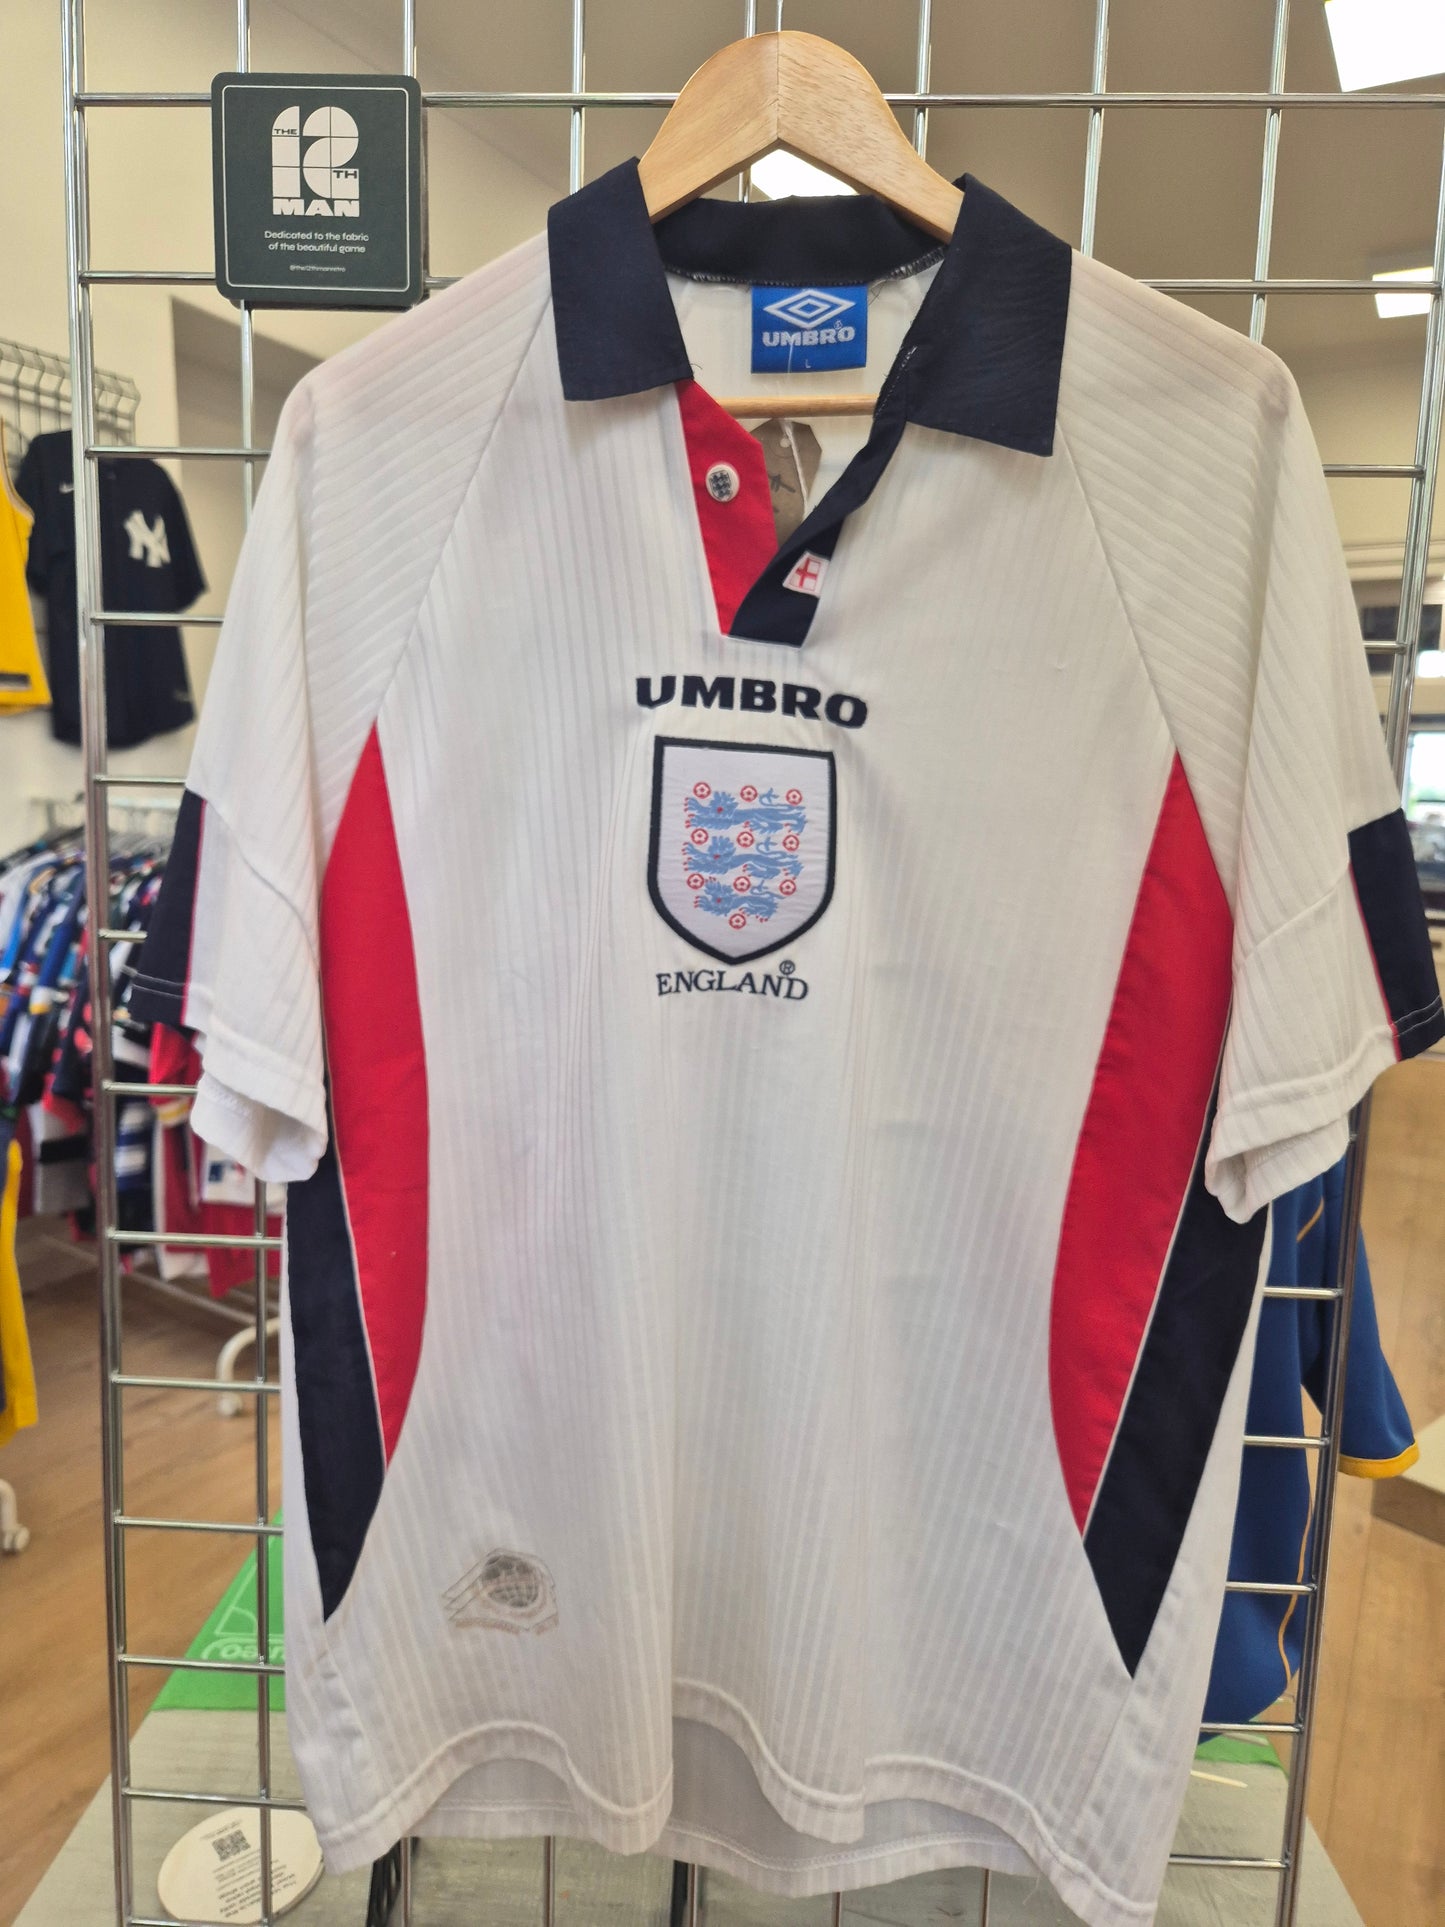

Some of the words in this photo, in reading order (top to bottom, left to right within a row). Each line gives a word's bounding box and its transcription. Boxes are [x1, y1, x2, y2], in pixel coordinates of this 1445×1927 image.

[333, 169, 358, 179] TH
[272, 198, 360, 218] MAN
[264, 230, 313, 240] Dedicated
[314, 232, 324, 240] to
[325, 232, 341, 241] the
[342, 232, 370, 242] fabric
[268, 242, 279, 250] of
[280, 243, 296, 251] the
[296, 243, 338, 252] beautiful
[339, 245, 366, 254] game
[762, 326, 856, 346] UMBRO
[805, 359, 812, 369] L
[636, 675, 868, 729] UMBRO
[656, 970, 809, 1001] ENGLAND
